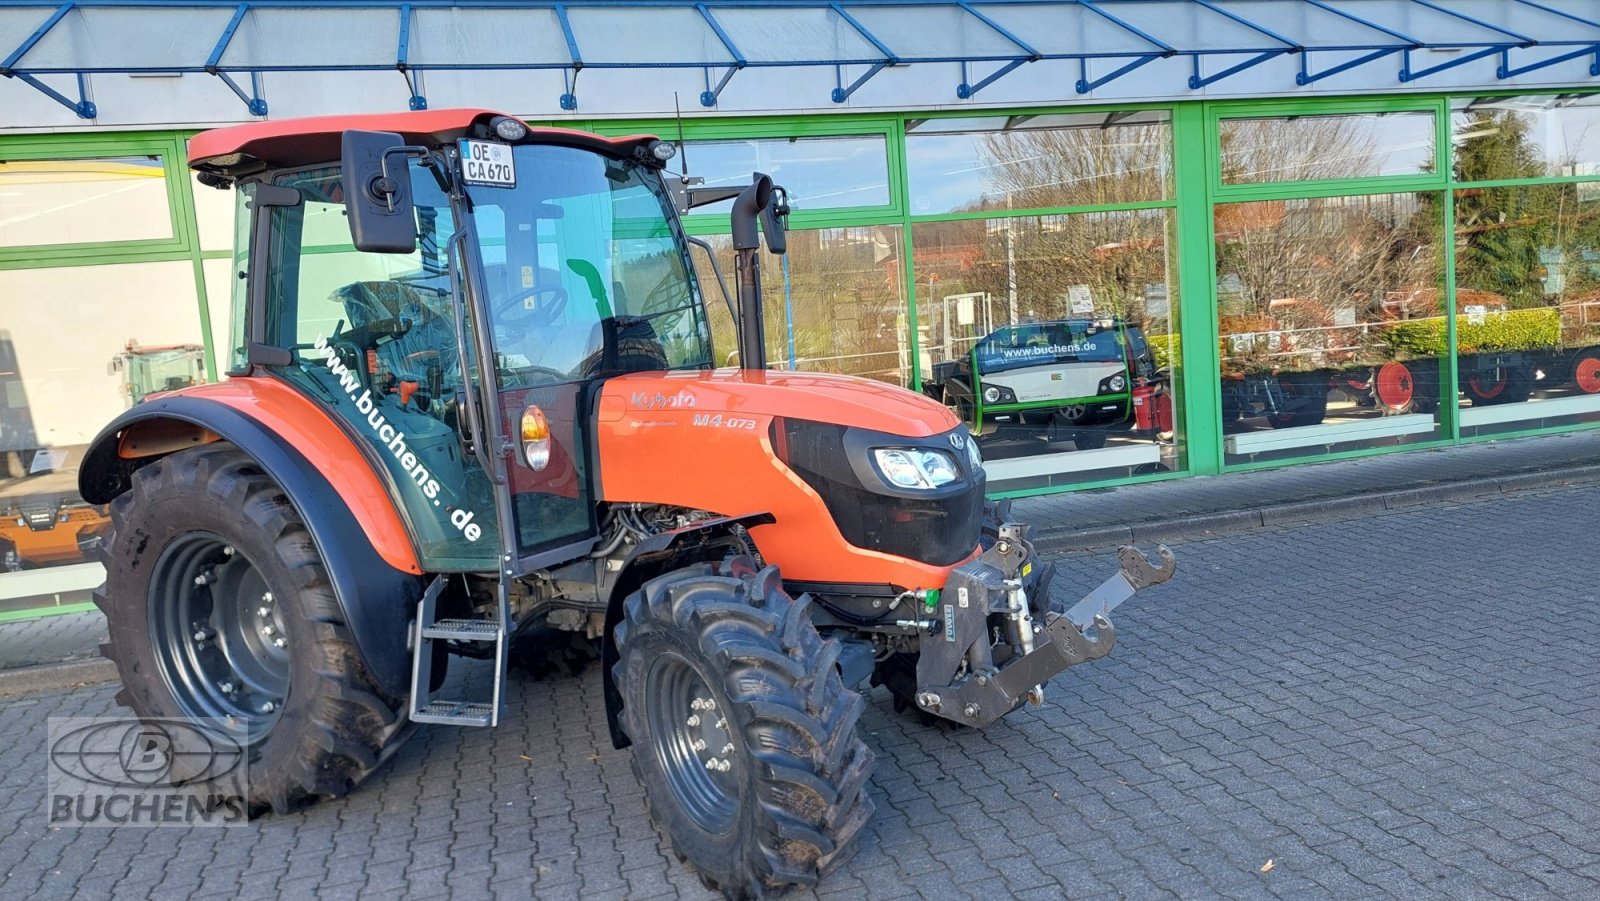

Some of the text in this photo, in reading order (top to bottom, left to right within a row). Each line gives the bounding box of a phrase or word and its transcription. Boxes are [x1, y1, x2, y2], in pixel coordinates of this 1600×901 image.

[472, 144, 491, 162] OE
[1003, 341, 1097, 358] www.buchens.de
[692, 414, 757, 430] M4-073
[450, 508, 482, 542] de
